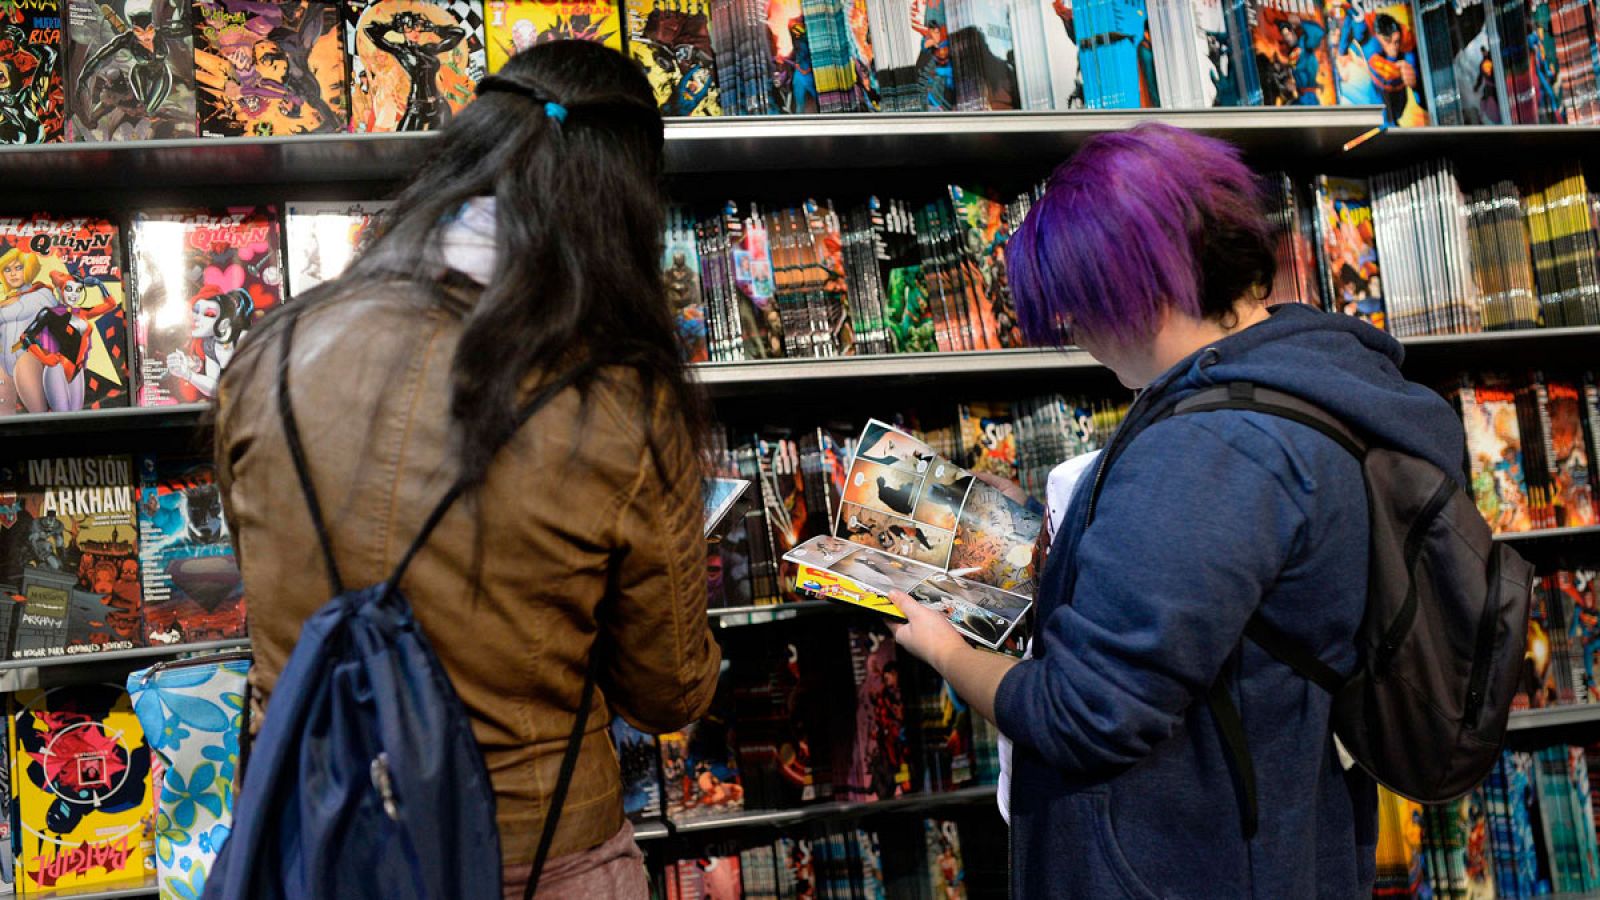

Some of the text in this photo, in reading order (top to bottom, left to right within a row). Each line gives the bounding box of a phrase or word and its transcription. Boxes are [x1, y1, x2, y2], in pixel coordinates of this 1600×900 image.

[28, 454, 129, 486] MANSIÓN
[43, 486, 132, 517] ARKHAM
[32, 836, 129, 888] BATGIRL
